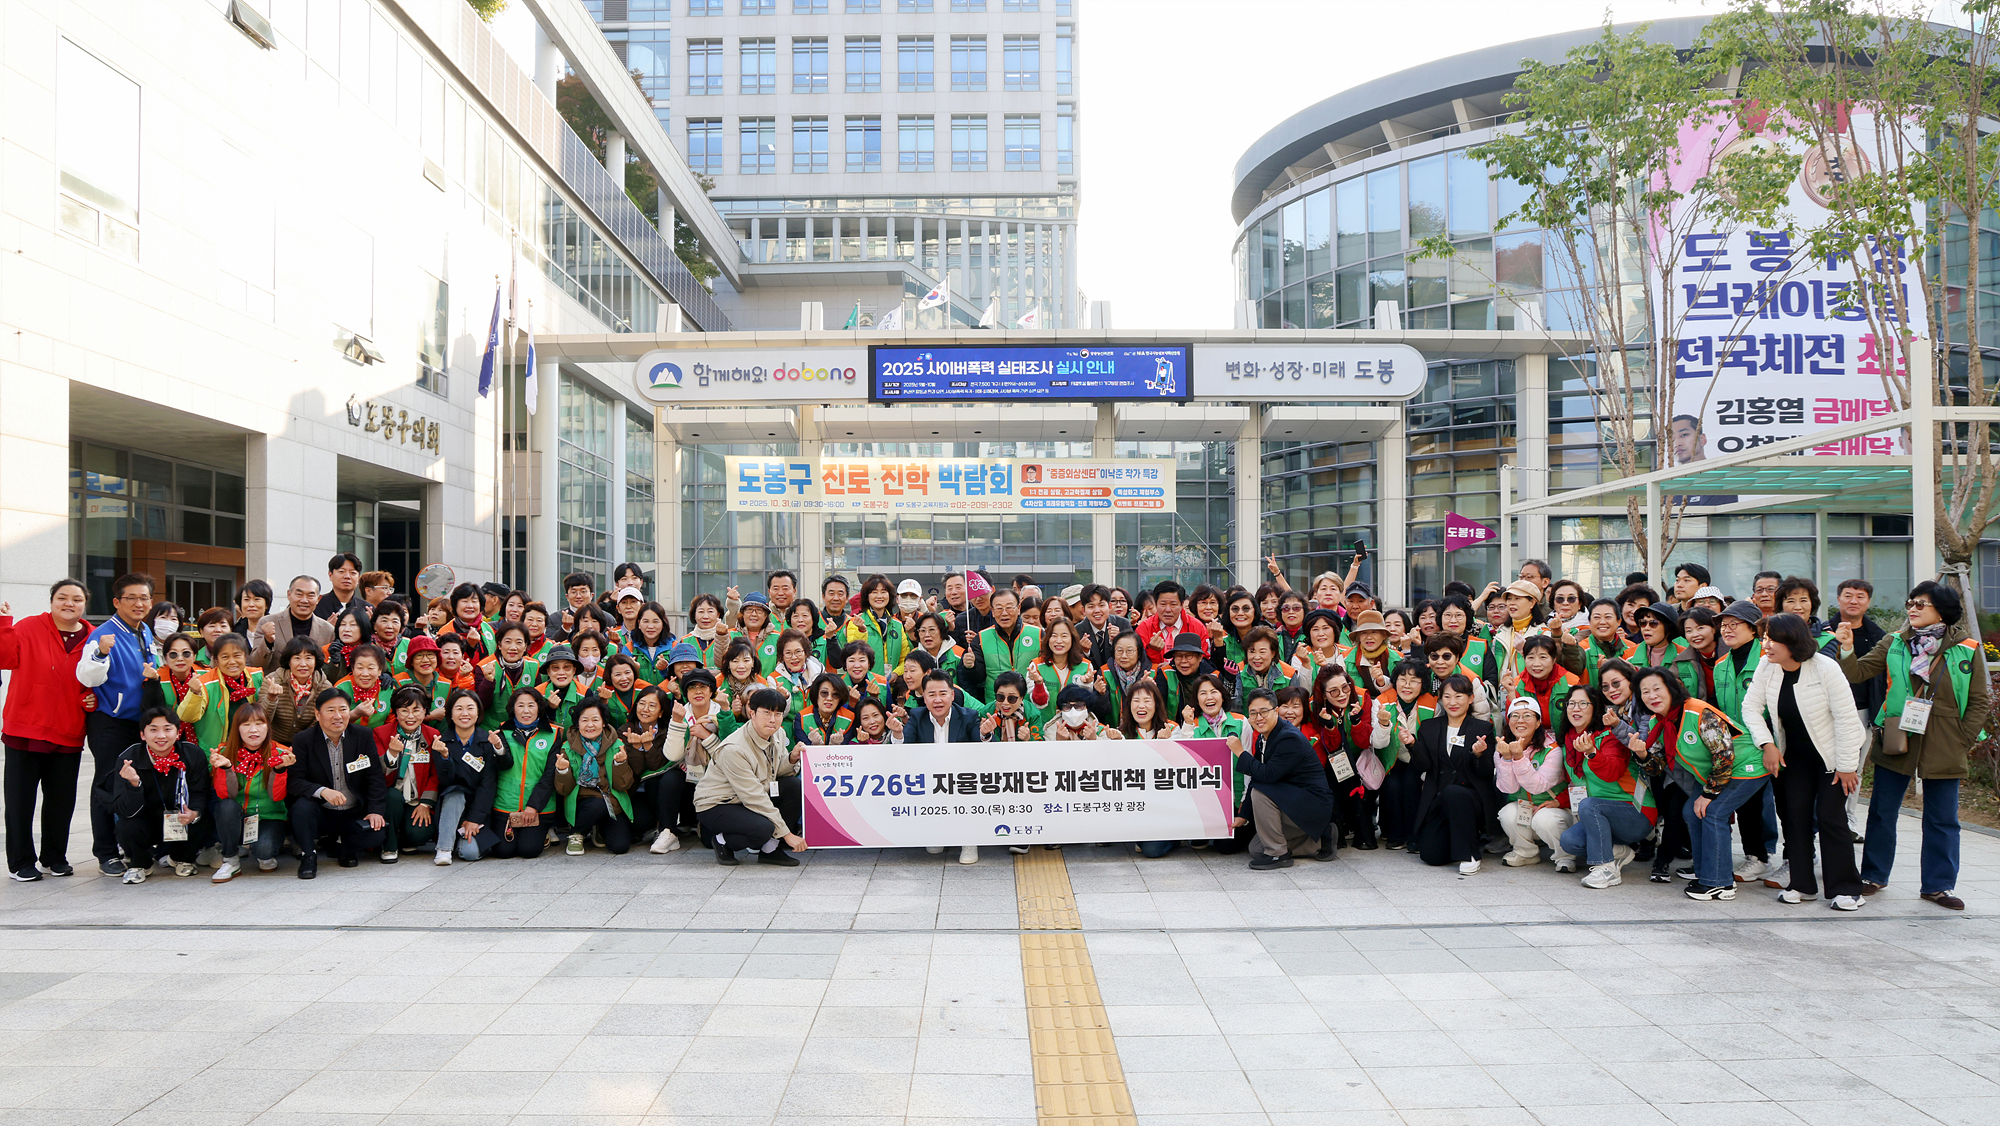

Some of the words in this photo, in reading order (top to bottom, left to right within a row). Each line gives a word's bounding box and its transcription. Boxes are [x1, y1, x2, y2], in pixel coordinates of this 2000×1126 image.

[1675, 333, 1845, 379] 전국체전
[693, 362, 767, 387] 함께해요!
[773, 361, 856, 385] dobong
[882, 362, 924, 376] 2025
[926, 360, 995, 376] 사이버폭력
[997, 360, 1054, 375] 실태조사
[1056, 360, 1084, 375] 실시
[1086, 360, 1115, 375] 안내
[1225, 360, 1346, 381] 변화·성장·미래
[1354, 359, 1395, 384] 도봉
[1716, 396, 1804, 425] 김홍열
[364, 400, 440, 456] 도봉구의회
[738, 462, 813, 495] 도봉구
[821, 462, 930, 496] 진로·진학
[938, 463, 1013, 496] 박람회
[1125, 468, 1141, 480] 작가
[1143, 468, 1158, 480] 특강
[770, 499, 780, 507] 10.
[803, 500, 845, 508] 09:30~16:00
[1447, 527, 1486, 538] 도봉1동
[969, 579, 990, 591] 창2
[826, 753, 854, 762] dobong
[932, 771, 1049, 796] 자율방재단
[1054, 768, 1146, 793] 제설대책
[1153, 765, 1222, 791] 발대식
[891, 806, 911, 817] 일시
[920, 806, 950, 816] 2025.
[953, 806, 968, 815] 10.
[970, 804, 1005, 816] 30.(목)
[1008, 804, 1033, 814] 8:30
[1043, 803, 1063, 814] 장소
[1072, 802, 1111, 813] 도봉구청
[1113, 802, 1124, 812] 앞
[1126, 801, 1146, 812] 광장
[1014, 825, 1043, 835] 도봉구
